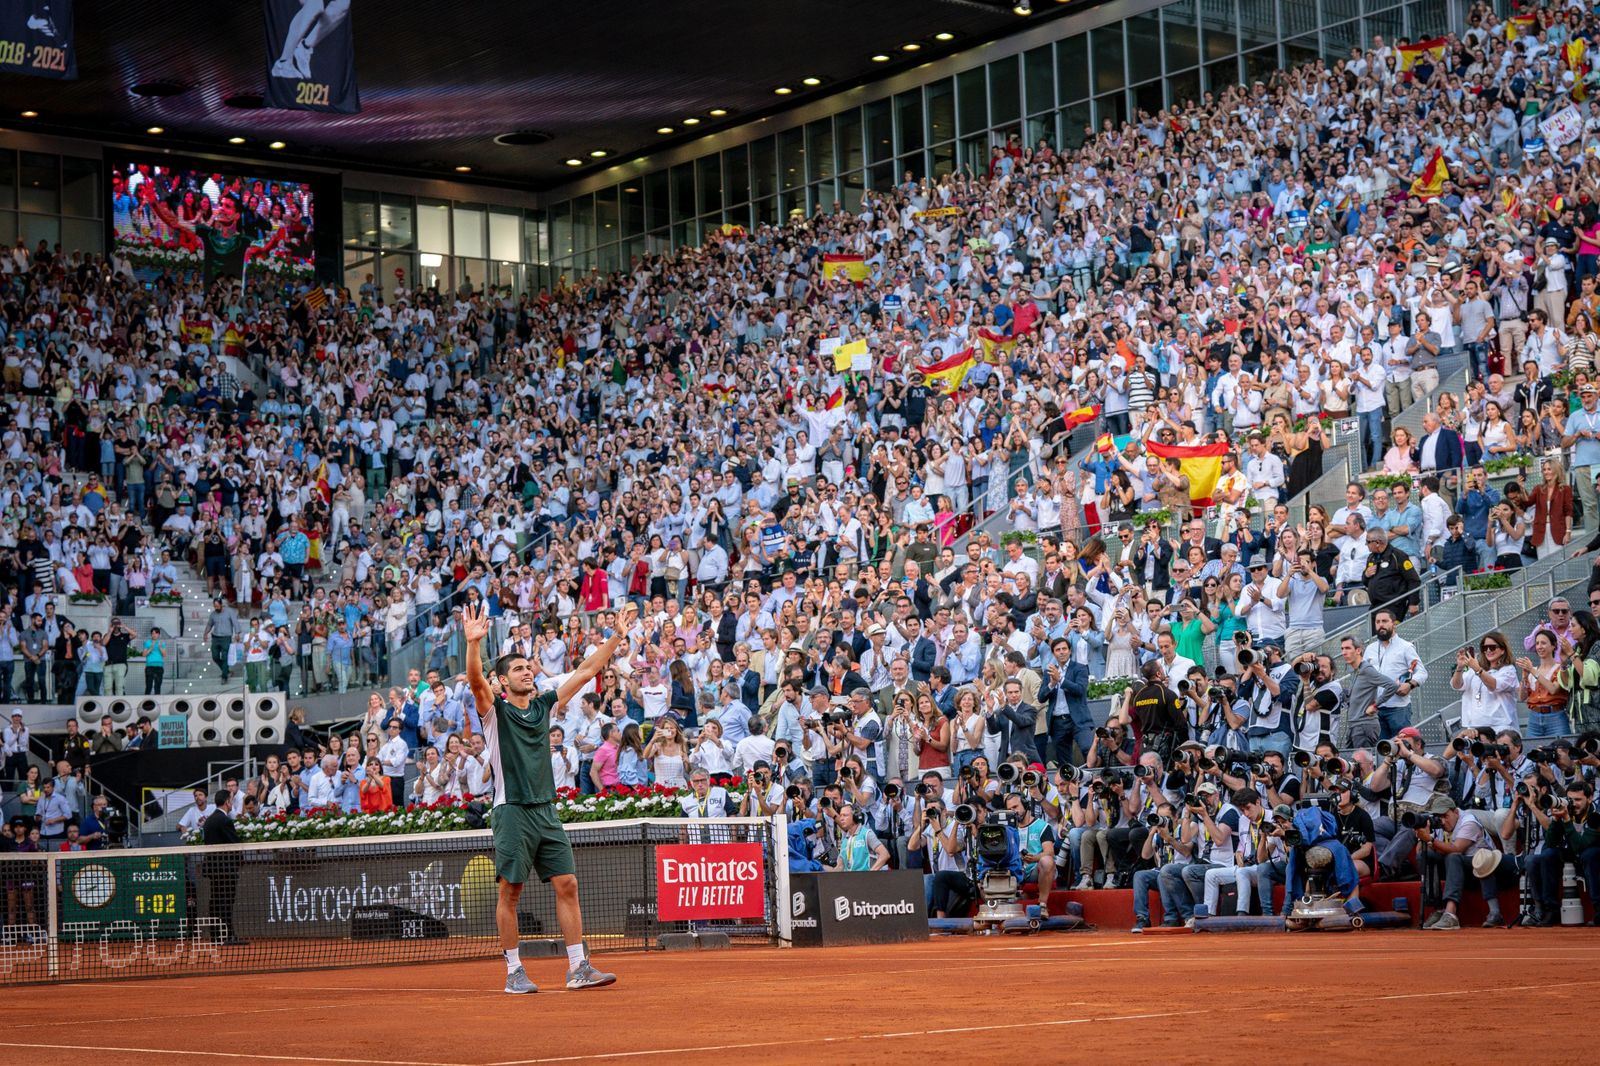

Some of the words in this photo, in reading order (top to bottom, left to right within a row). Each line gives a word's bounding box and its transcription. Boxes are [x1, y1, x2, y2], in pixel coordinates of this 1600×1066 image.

[32, 46, 65, 71] 2021
[295, 82, 329, 105] 2021
[131, 870, 178, 882] ROLEX
[662, 856, 759, 884] Emirates
[134, 893, 176, 914] 1:02
[677, 886, 699, 907] FLY
[701, 884, 745, 906] BETTER
[852, 900, 915, 920] bitpanda
